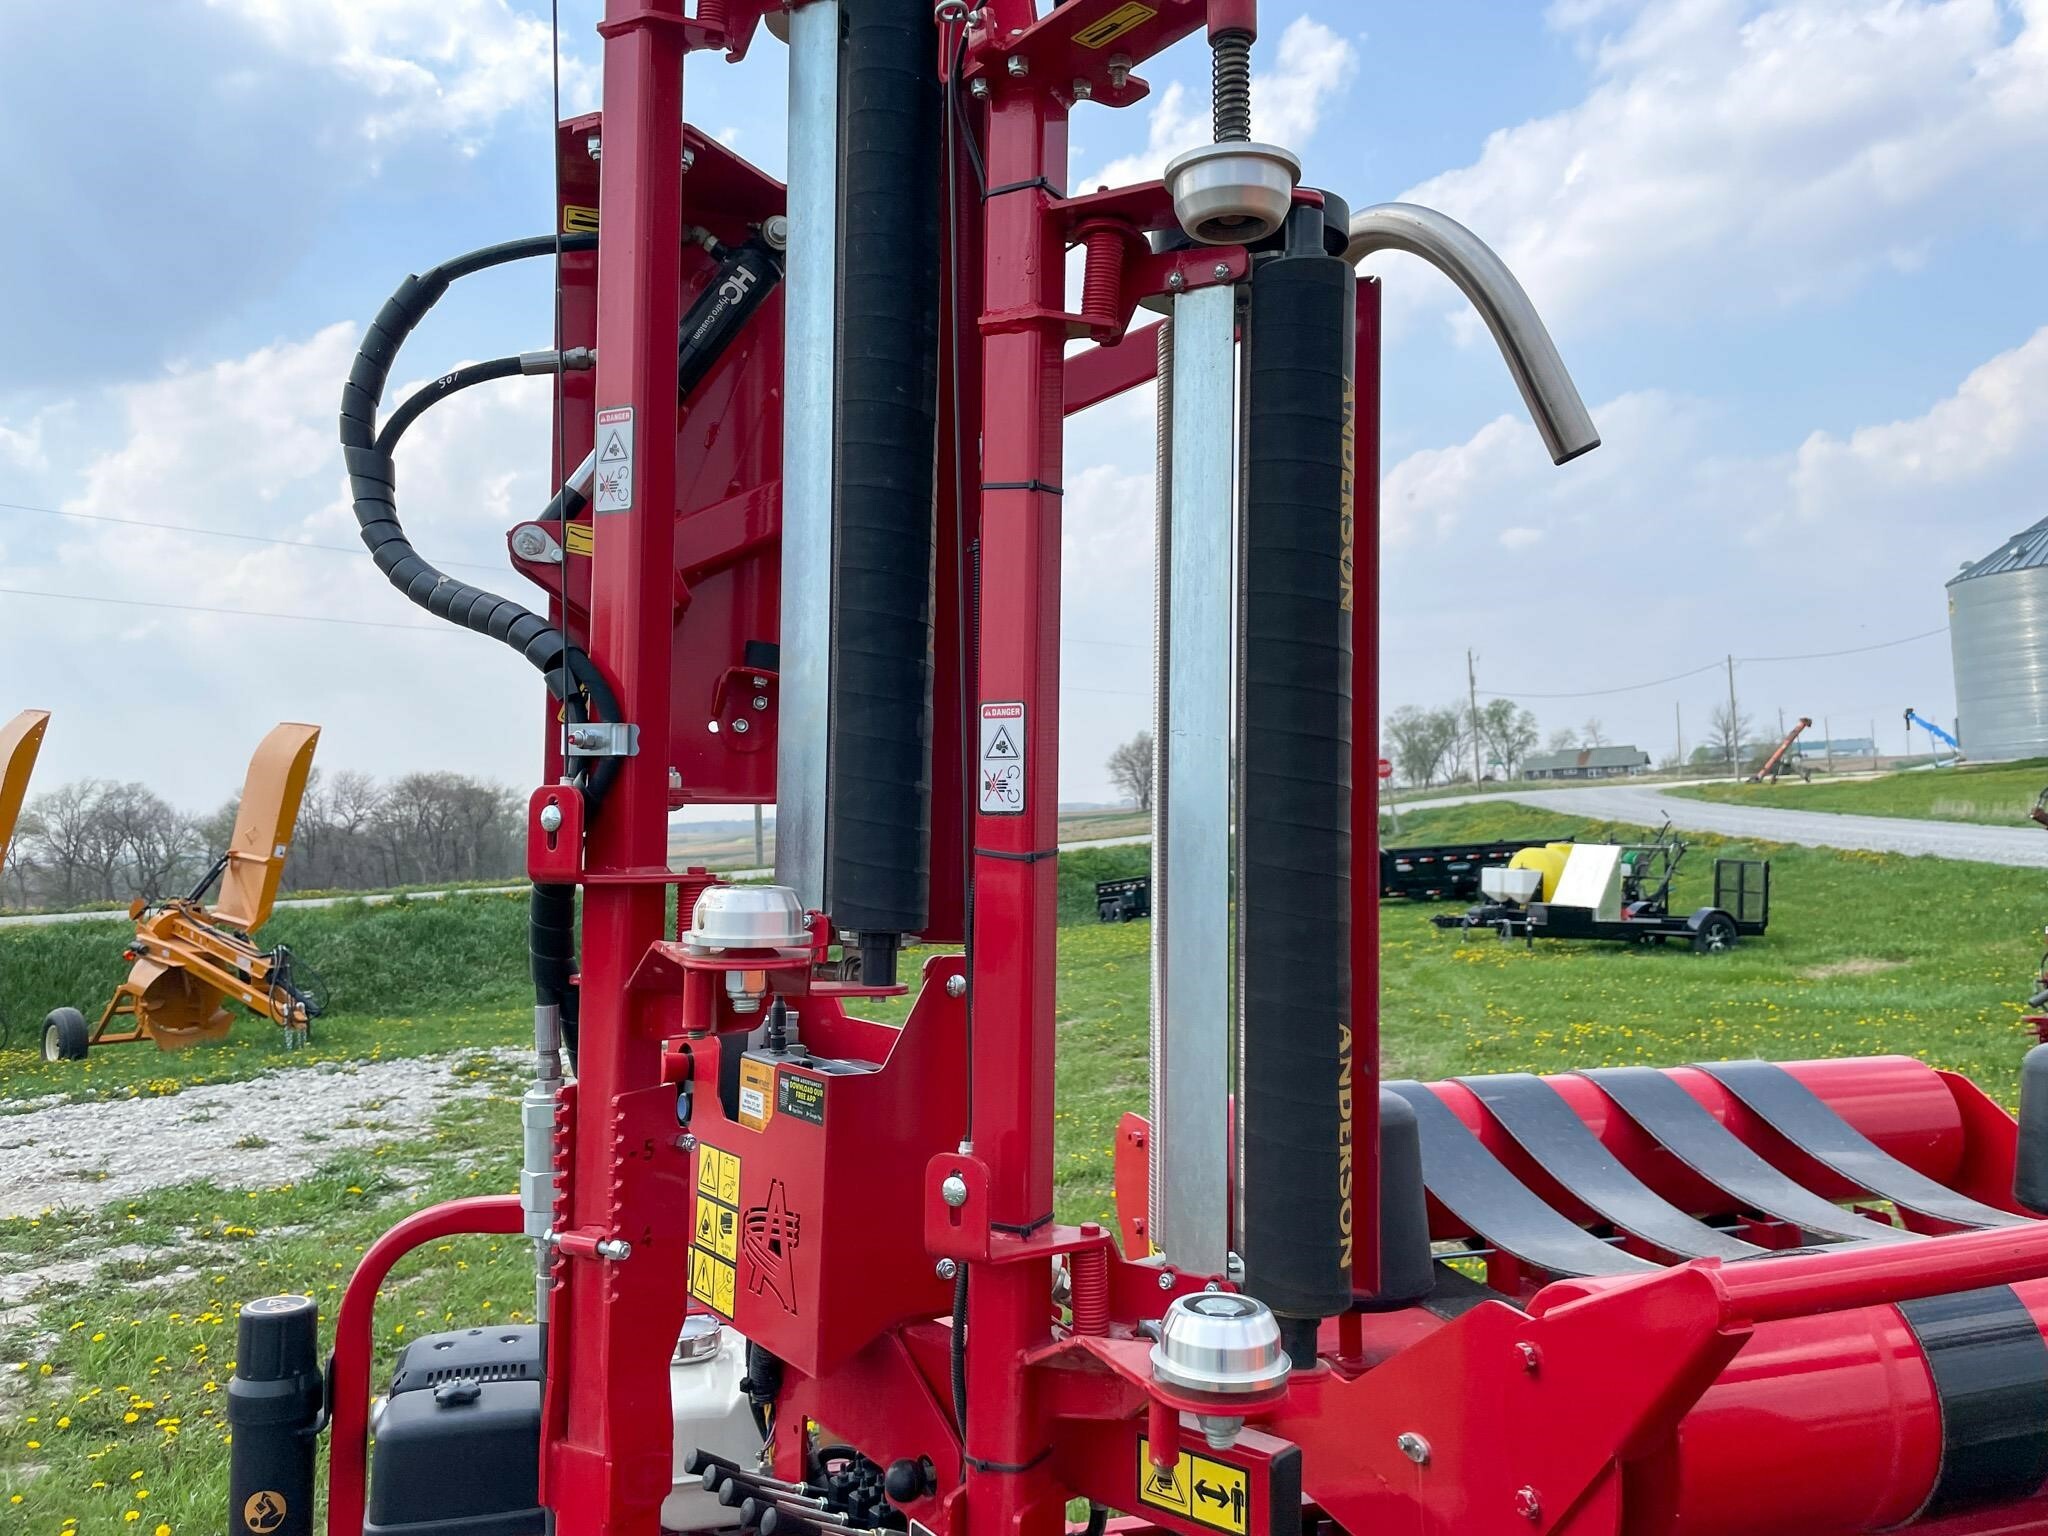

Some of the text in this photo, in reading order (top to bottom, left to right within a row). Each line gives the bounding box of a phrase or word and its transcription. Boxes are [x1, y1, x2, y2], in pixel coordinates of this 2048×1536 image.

[719, 265, 757, 305] HC
[693, 296, 730, 340] Hydro Custom
[606, 411, 630, 423] DANGER
[991, 706, 1021, 717] DANGER
[789, 1081, 813, 1094] DOWNLOAD
[795, 1090, 806, 1100] FREE
[806, 1093, 817, 1102] APP
[1339, 1023, 1353, 1269] ANDERSON
